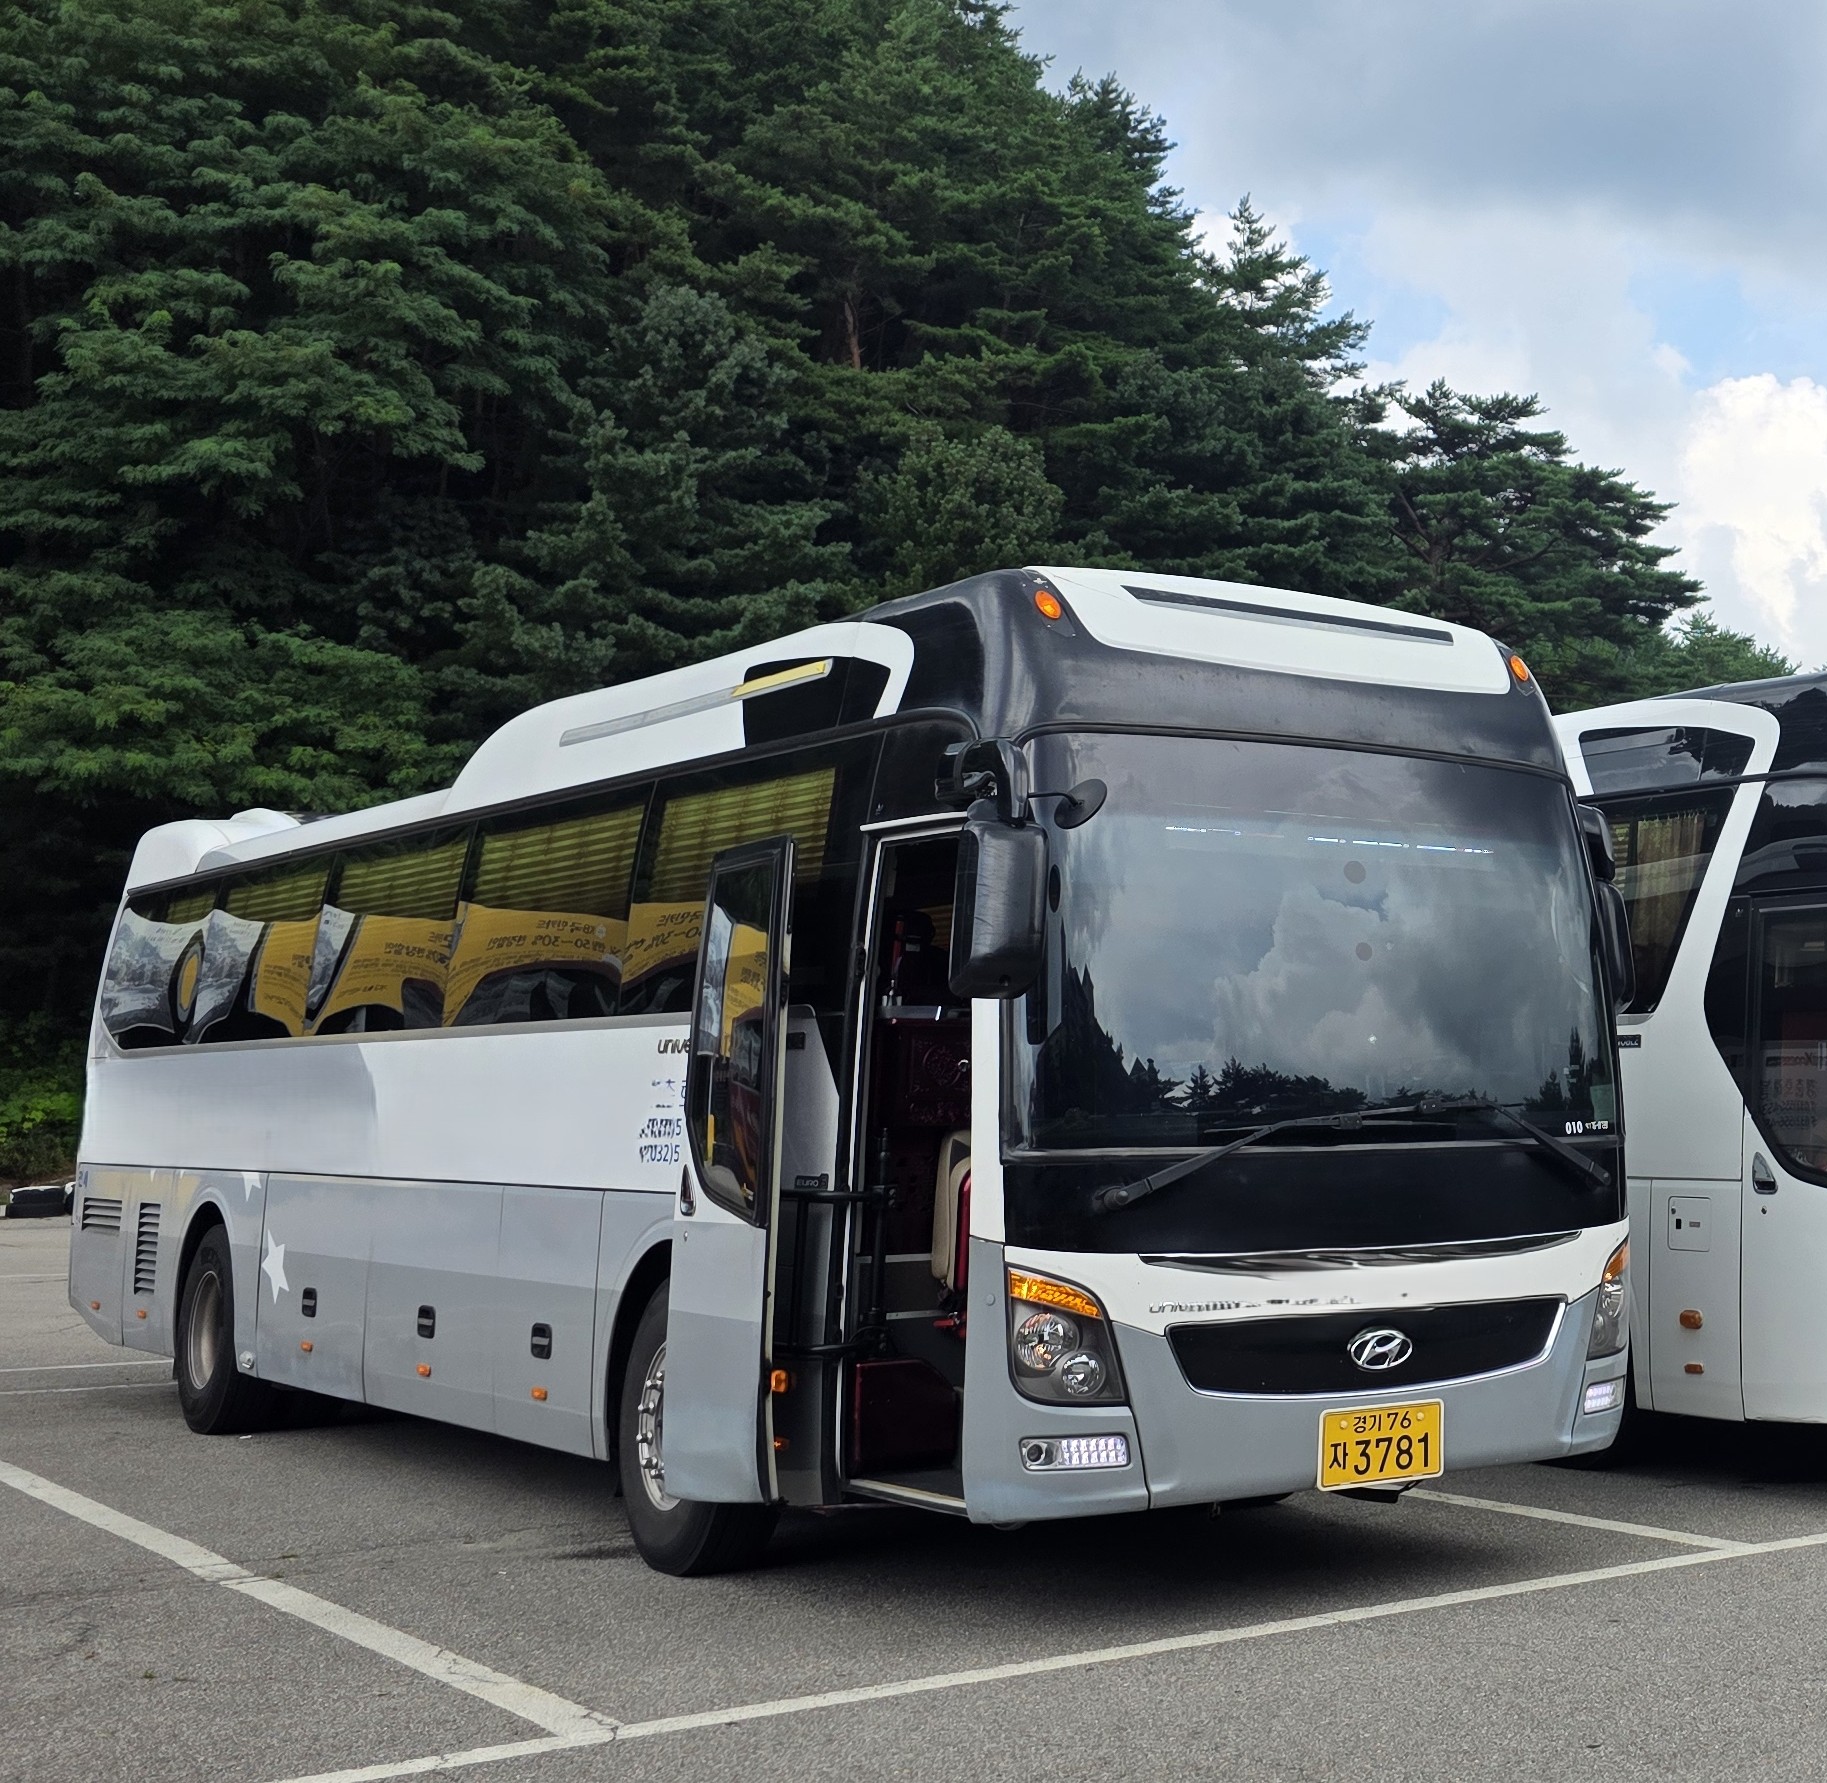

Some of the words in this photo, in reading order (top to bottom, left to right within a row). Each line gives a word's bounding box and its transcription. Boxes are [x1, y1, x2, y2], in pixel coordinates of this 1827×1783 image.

[1352, 1413, 1382, 1434] 경기
[1386, 1410, 1412, 1430] 76
[1328, 1441, 1349, 1470] 자
[1353, 1431, 1429, 1475] 3781
